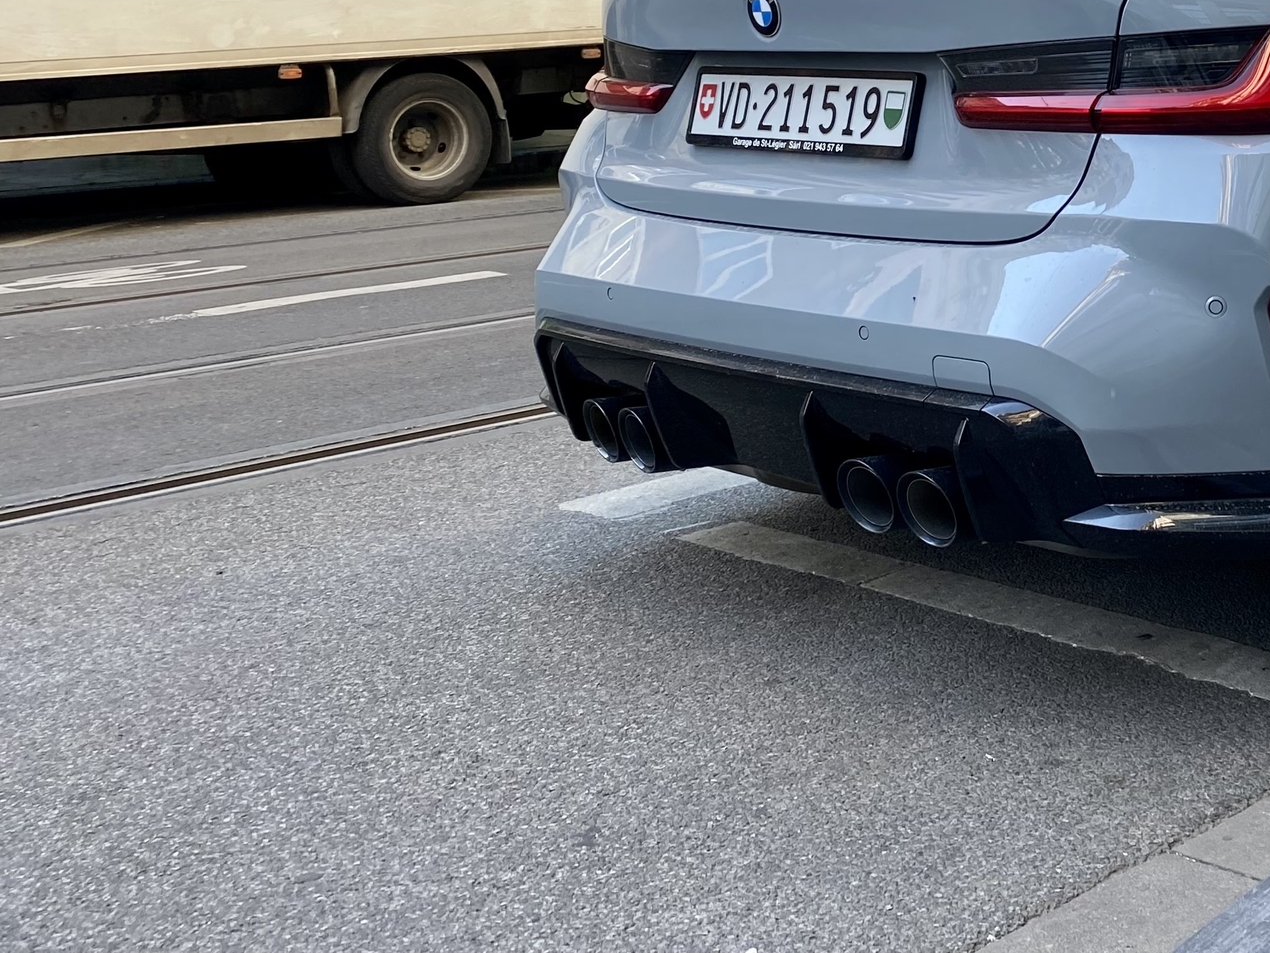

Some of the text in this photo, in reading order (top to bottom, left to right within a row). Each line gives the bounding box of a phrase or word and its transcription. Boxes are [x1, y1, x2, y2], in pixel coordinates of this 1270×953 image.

[732, 137, 752, 148] Garage
[752, 138, 760, 147] de
[803, 141, 814, 150] 021
[826, 143, 835, 152] 57
[835, 143, 844, 153] 64
